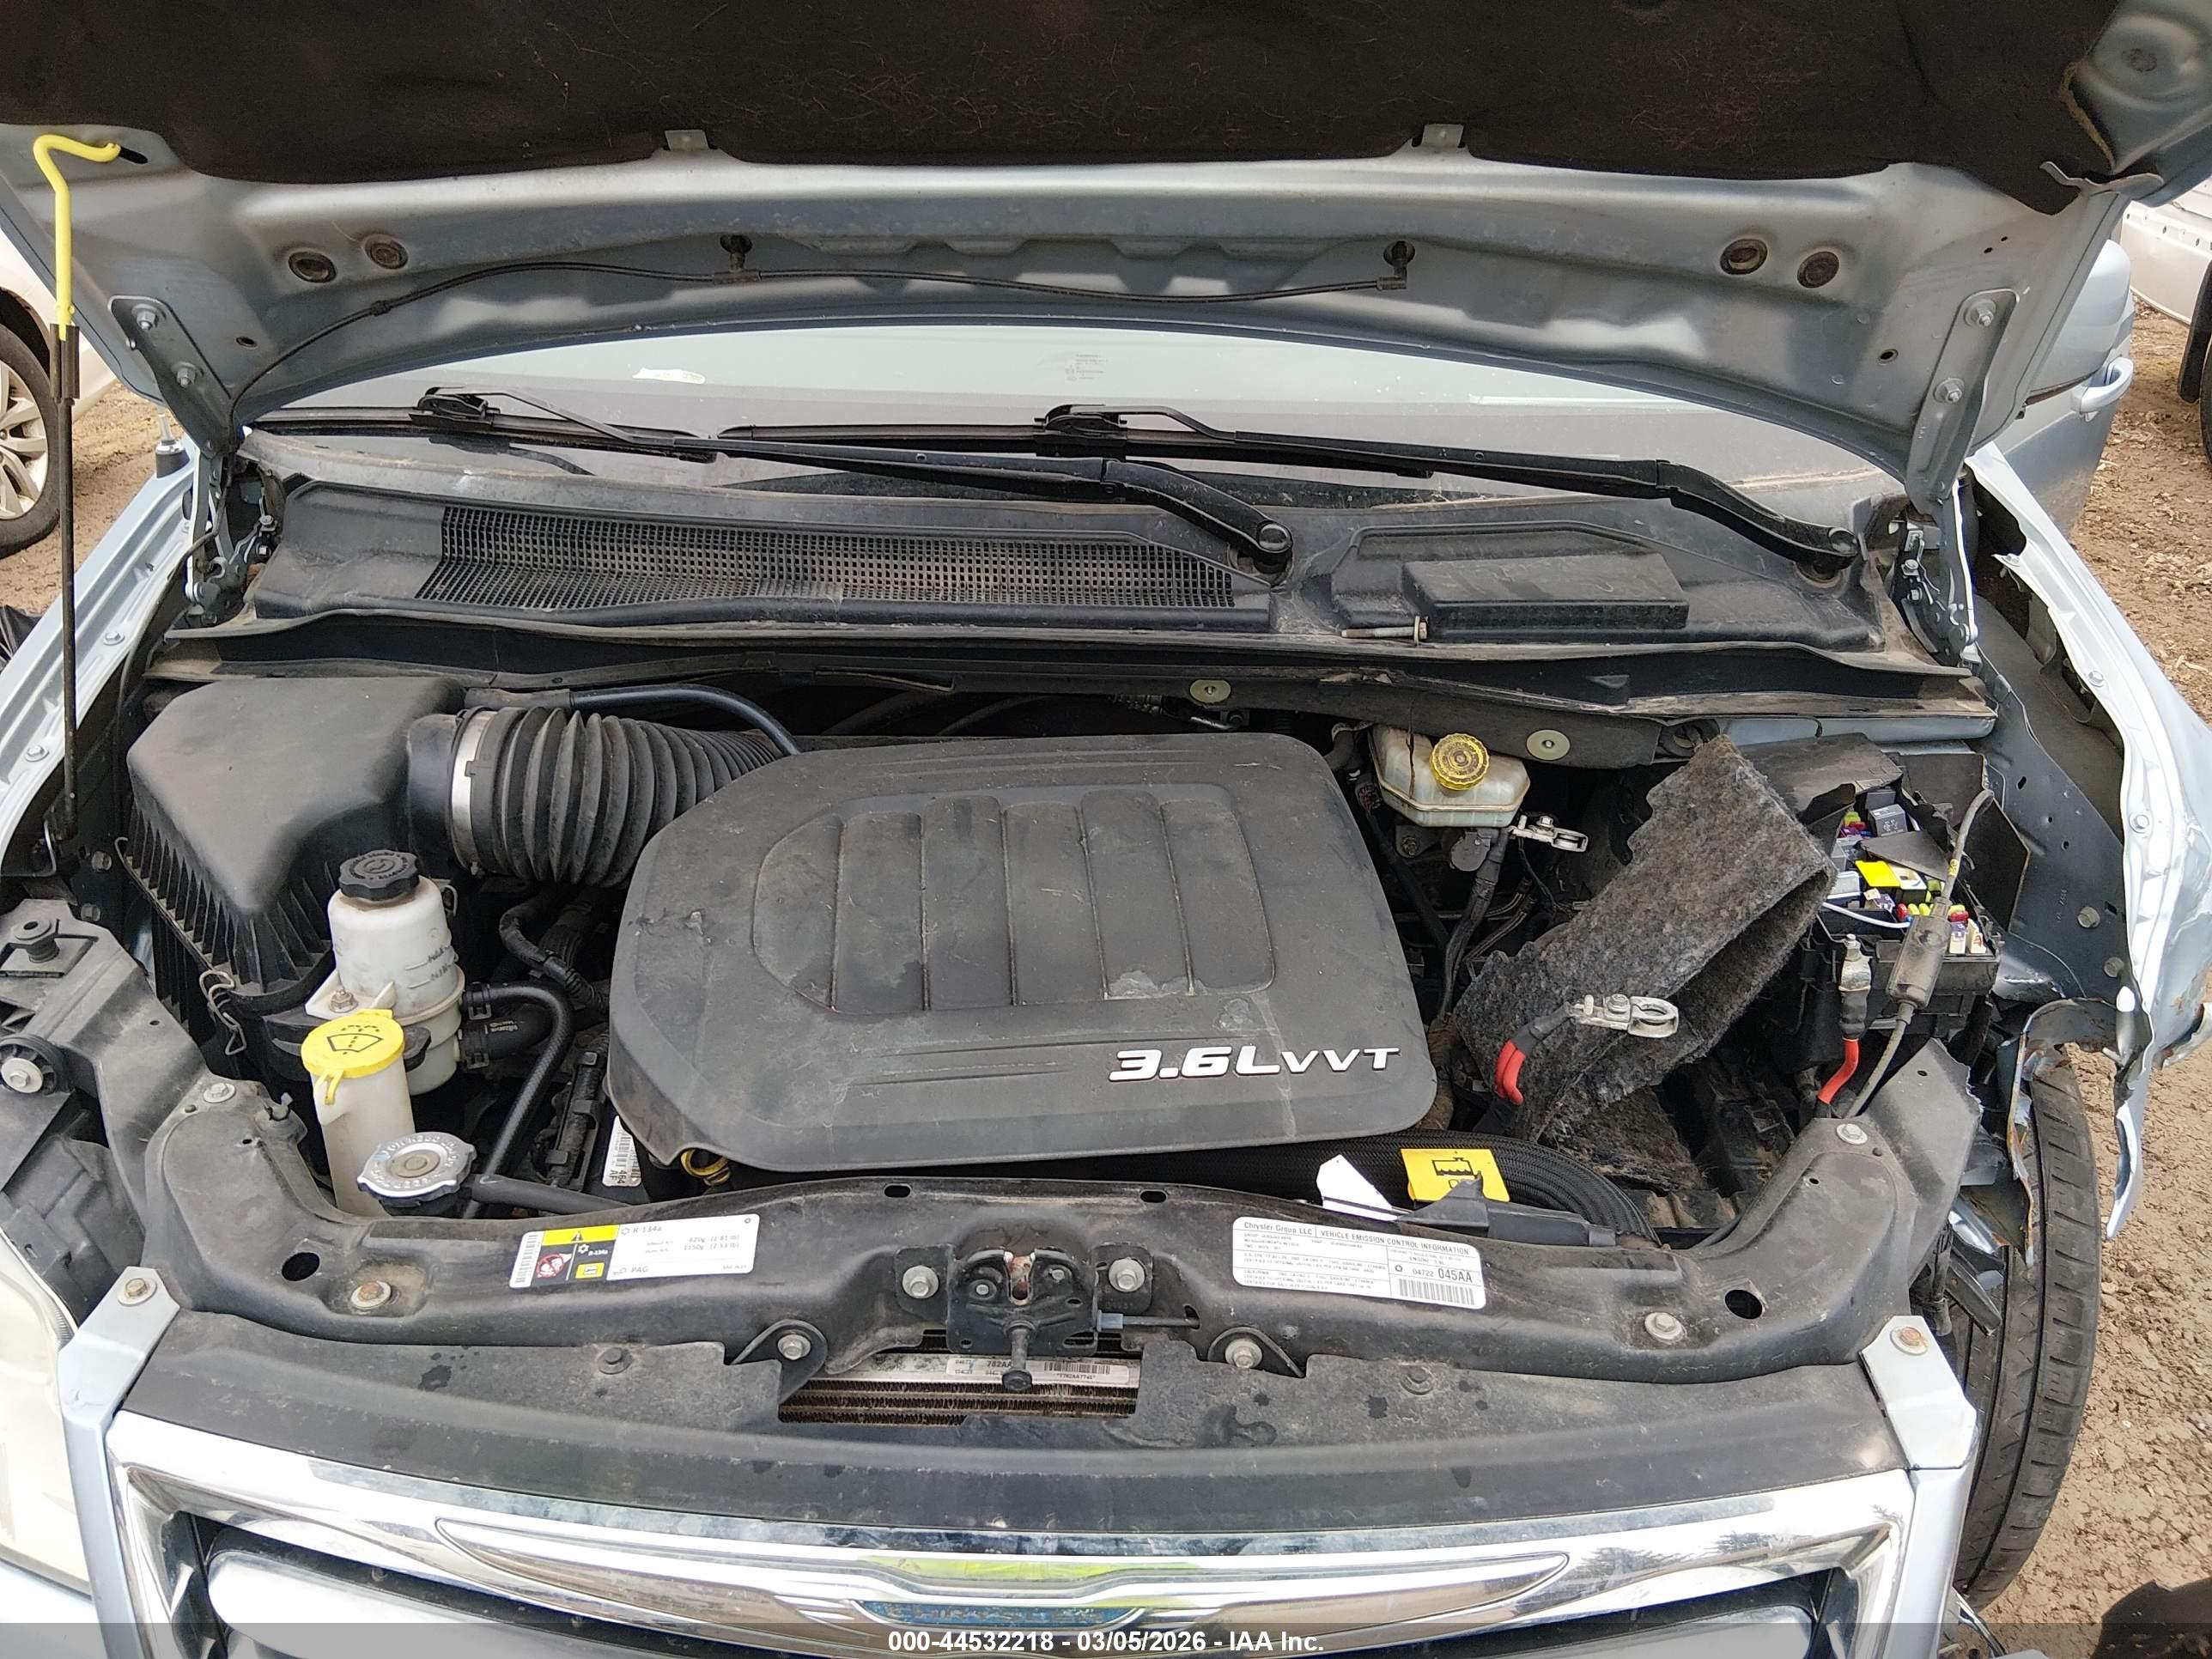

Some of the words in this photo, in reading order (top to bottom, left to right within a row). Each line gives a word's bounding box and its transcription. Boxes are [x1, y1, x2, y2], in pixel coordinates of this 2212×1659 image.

[1243, 1221, 1273, 1231] Chrysler
[1275, 1224, 1297, 1235] Group
[1320, 1231, 1350, 1240] VEHICLE
[1352, 1233, 1385, 1244] EMISSION
[1387, 1237, 1419, 1249] CONTROL
[1421, 1242, 1469, 1255] INFORMATION
[1437, 1267, 1473, 1283] 045AA
